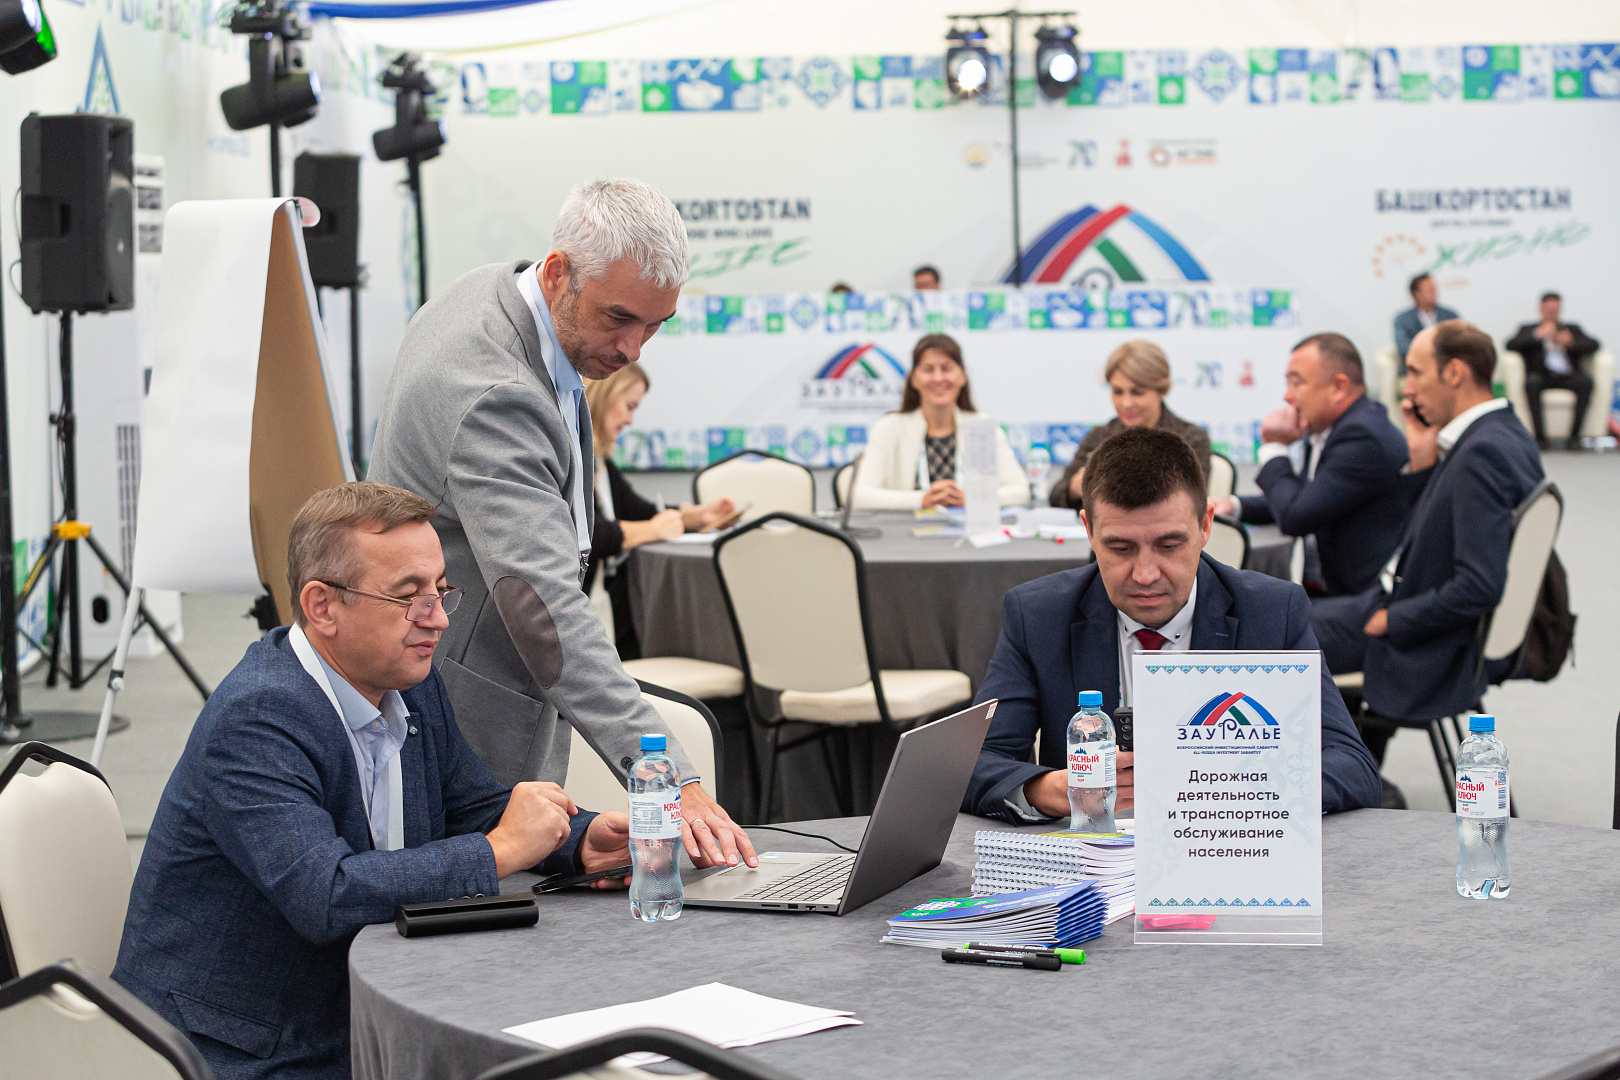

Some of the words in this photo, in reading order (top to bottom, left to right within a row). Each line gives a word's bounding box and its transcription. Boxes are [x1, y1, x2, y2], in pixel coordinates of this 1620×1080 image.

[1375, 187, 1572, 213] БАШКОРТОСТАН
[676, 198, 811, 220] KORTOSTAN
[1177, 718, 1281, 740] ЗАУРАЛЬЕ
[1071, 763, 1093, 772] КЛЮЧ
[1188, 769, 1268, 785] Дорожная
[1177, 791, 1280, 802] деятельность
[1168, 810, 1177, 820] и
[1181, 810, 1290, 822] транспортное
[1173, 827, 1284, 841] обслуживание
[1188, 848, 1270, 858] населения
